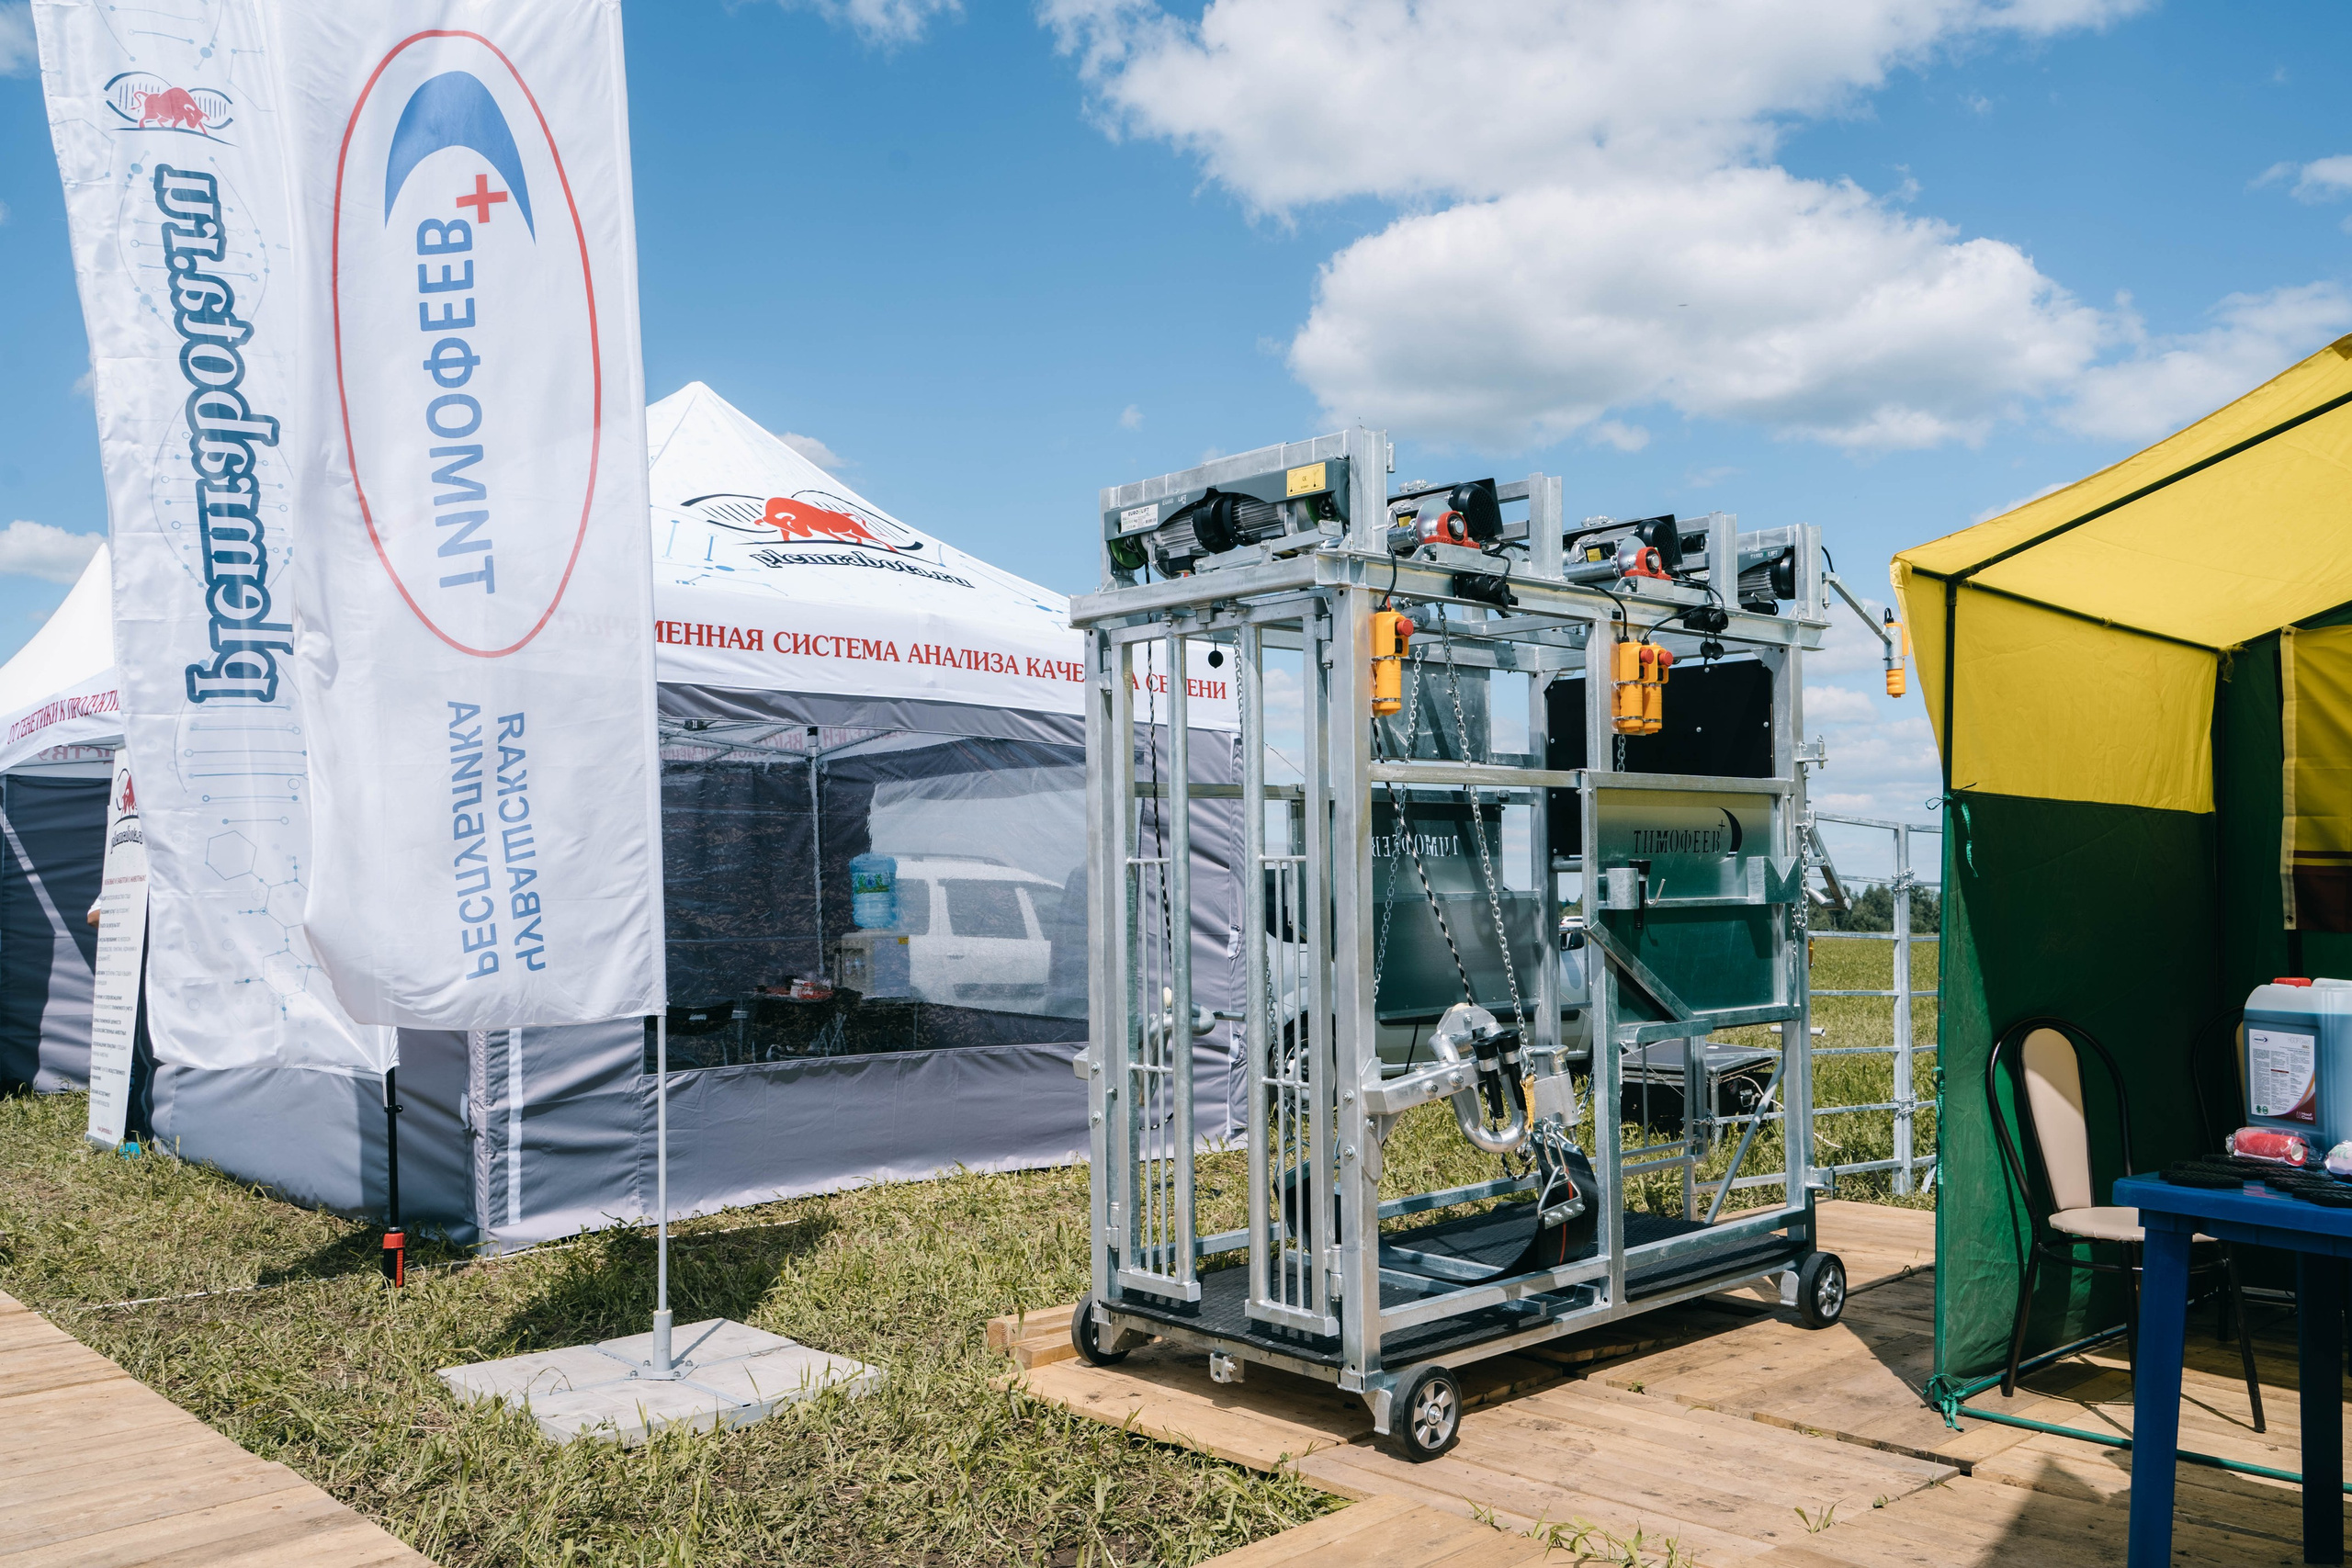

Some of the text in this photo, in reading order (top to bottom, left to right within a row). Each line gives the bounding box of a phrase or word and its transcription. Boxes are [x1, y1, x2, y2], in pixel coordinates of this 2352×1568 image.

[750, 549, 976, 589] plemrabota.ru
[773, 631, 900, 662] СИСТЕМА
[908, 642, 1020, 675] АНАЛИЗА
[1146, 673, 1227, 700] СЕЕНИ
[59, 699, 67, 722] К
[1634, 829, 1720, 853] ТИМОФЕЕВ
